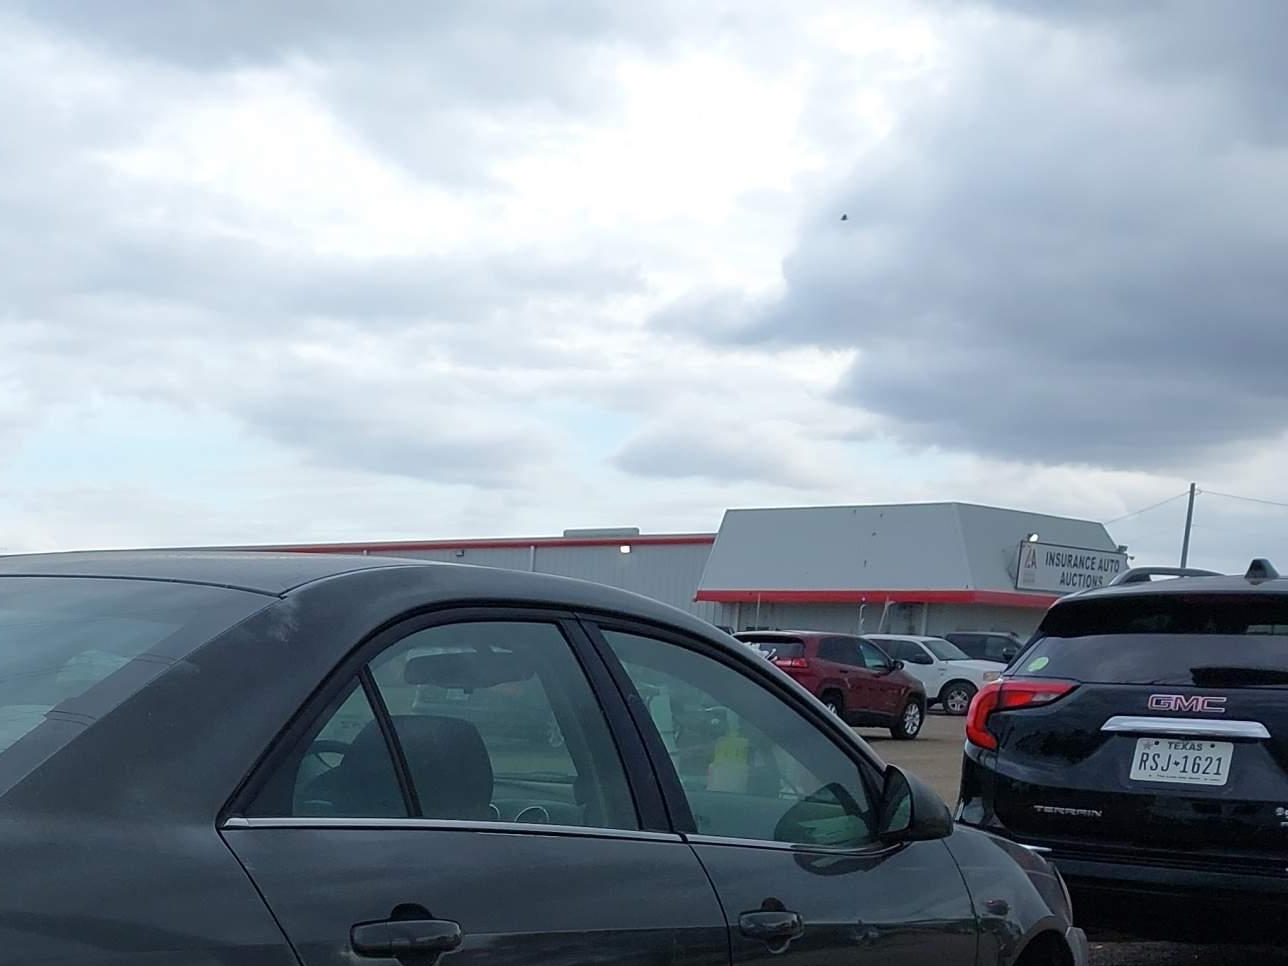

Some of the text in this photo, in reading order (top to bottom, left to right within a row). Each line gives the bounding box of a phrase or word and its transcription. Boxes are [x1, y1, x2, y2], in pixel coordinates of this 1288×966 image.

[1045, 551, 1096, 570] INSURANCE
[1098, 559, 1120, 573] AUTO
[1060, 572, 1103, 588] AUCTIONS
[1148, 694, 1227, 713] GMC
[1168, 741, 1203, 751] TEXAS
[1139, 752, 1223, 775] RSJ 1621
[1033, 805, 1103, 817] TERRAIN
